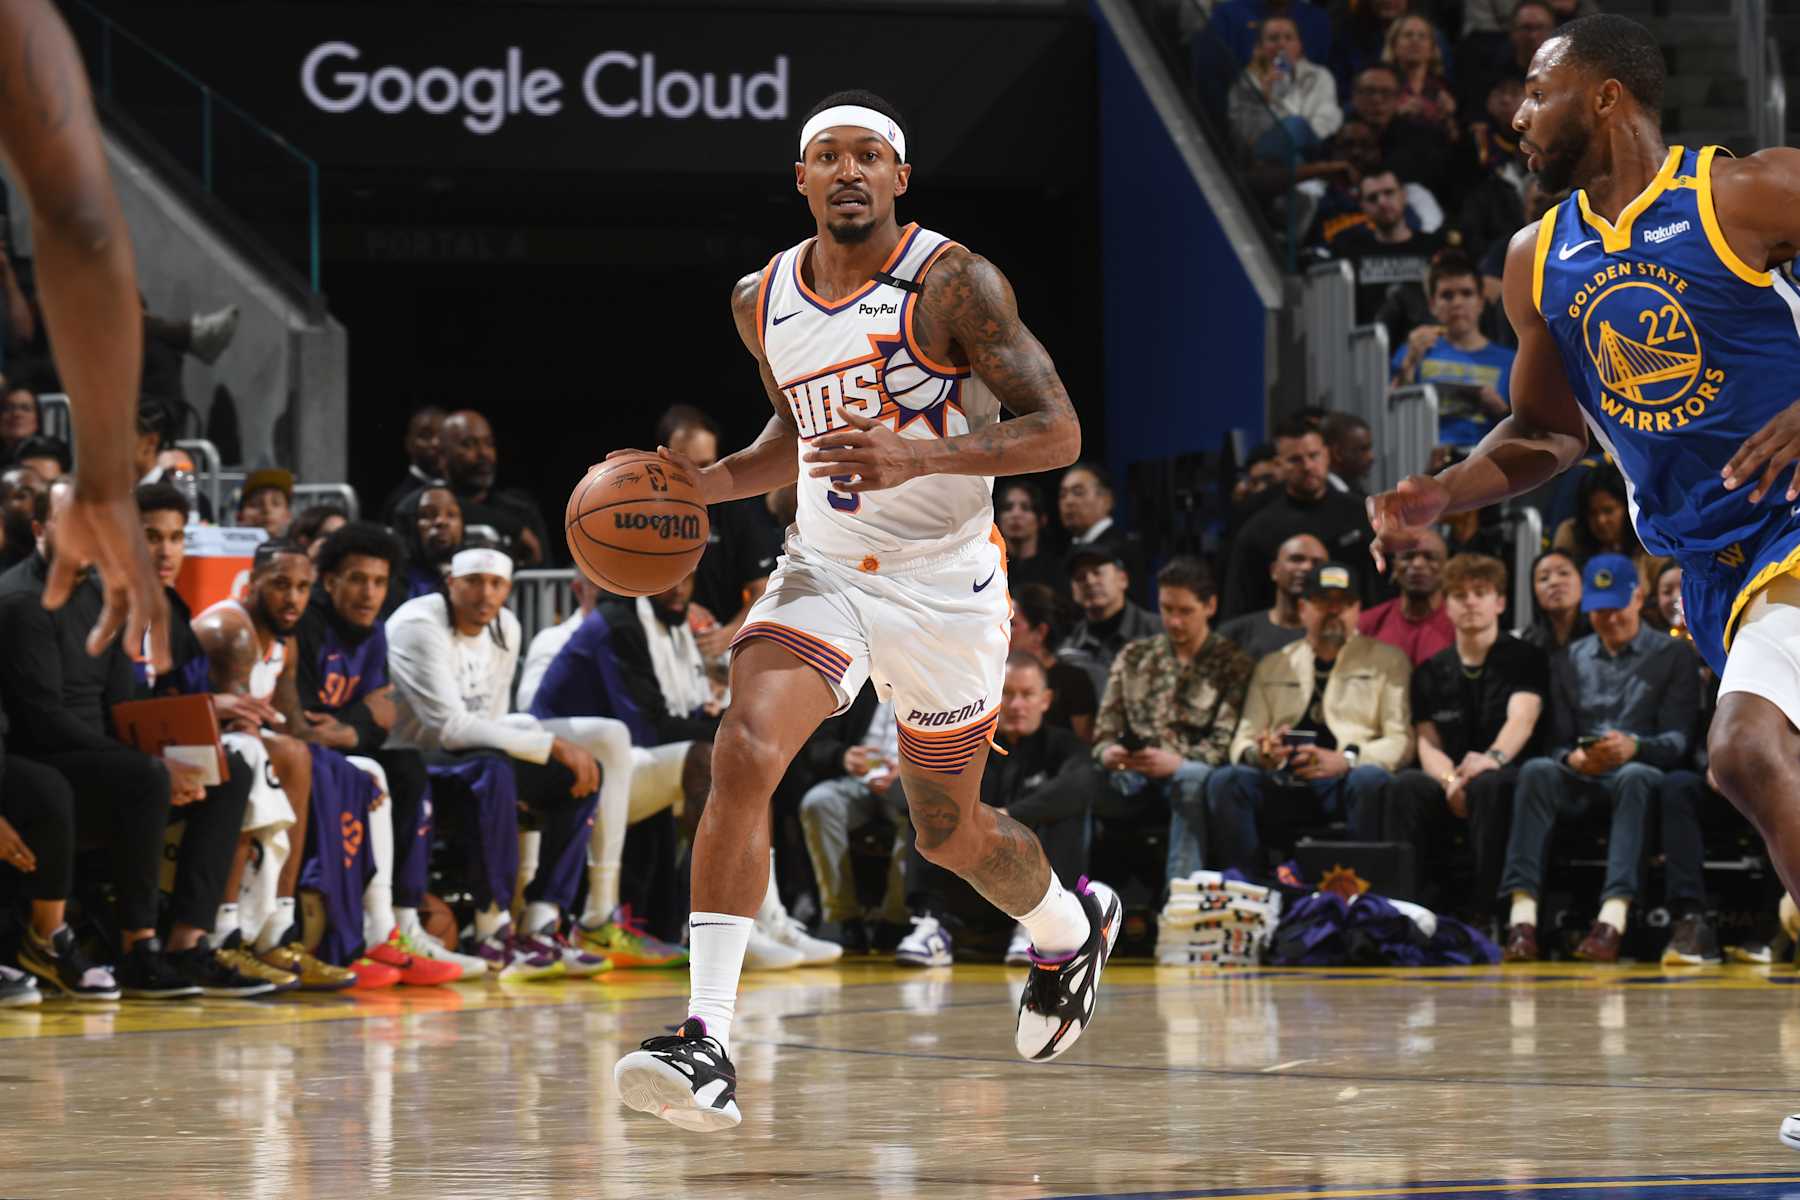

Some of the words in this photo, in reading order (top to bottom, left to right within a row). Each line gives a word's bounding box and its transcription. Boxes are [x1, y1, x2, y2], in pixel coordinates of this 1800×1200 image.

[300, 40, 563, 135] Google
[583, 50, 789, 119] Cloud
[1643, 220, 1691, 243] Rakuten
[858, 303, 898, 318] PayPal
[1568, 262, 1631, 319] GOLDEN
[1637, 262, 1689, 295] STATE
[1638, 304, 1687, 346] 22
[782, 364, 882, 439] UNS
[1600, 368, 1726, 432] WARRIORS
[612, 510, 700, 540] Wilson
[907, 695, 988, 727] PHOENIX
